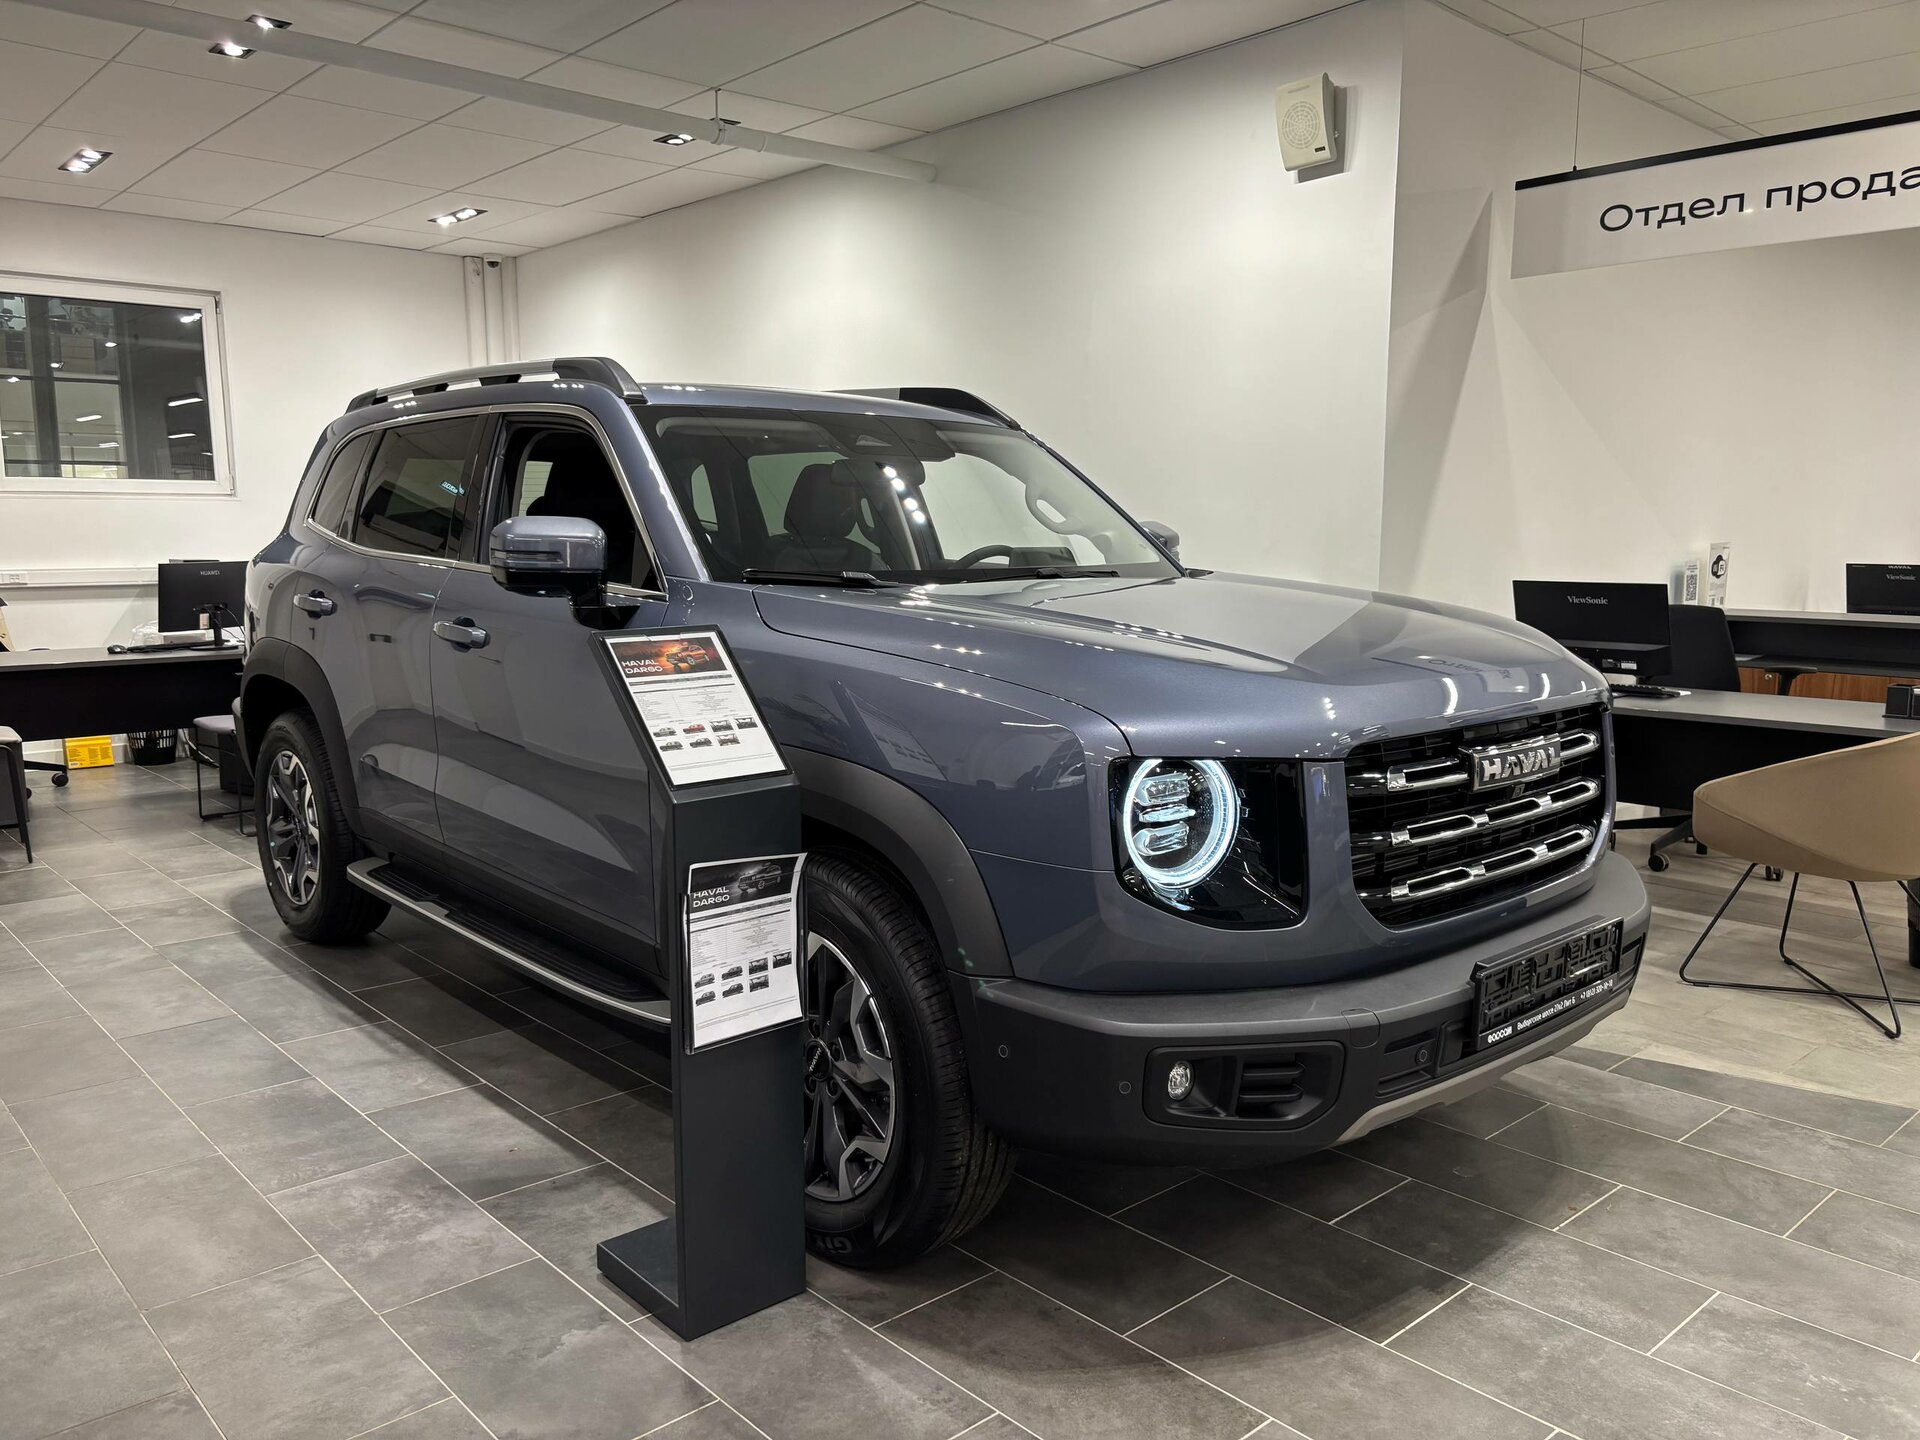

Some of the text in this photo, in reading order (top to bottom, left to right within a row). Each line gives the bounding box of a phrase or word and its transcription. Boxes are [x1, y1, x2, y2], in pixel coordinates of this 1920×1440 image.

[1600, 166, 1920, 232] Отдел прода
[1567, 595, 1609, 605] ViewSonic
[621, 659, 660, 667] HAVAL
[625, 665, 663, 674] DARGO
[1481, 747, 1560, 782] HAVAL
[693, 886, 730, 899] HAVAL
[693, 894, 730, 908] DARGO
